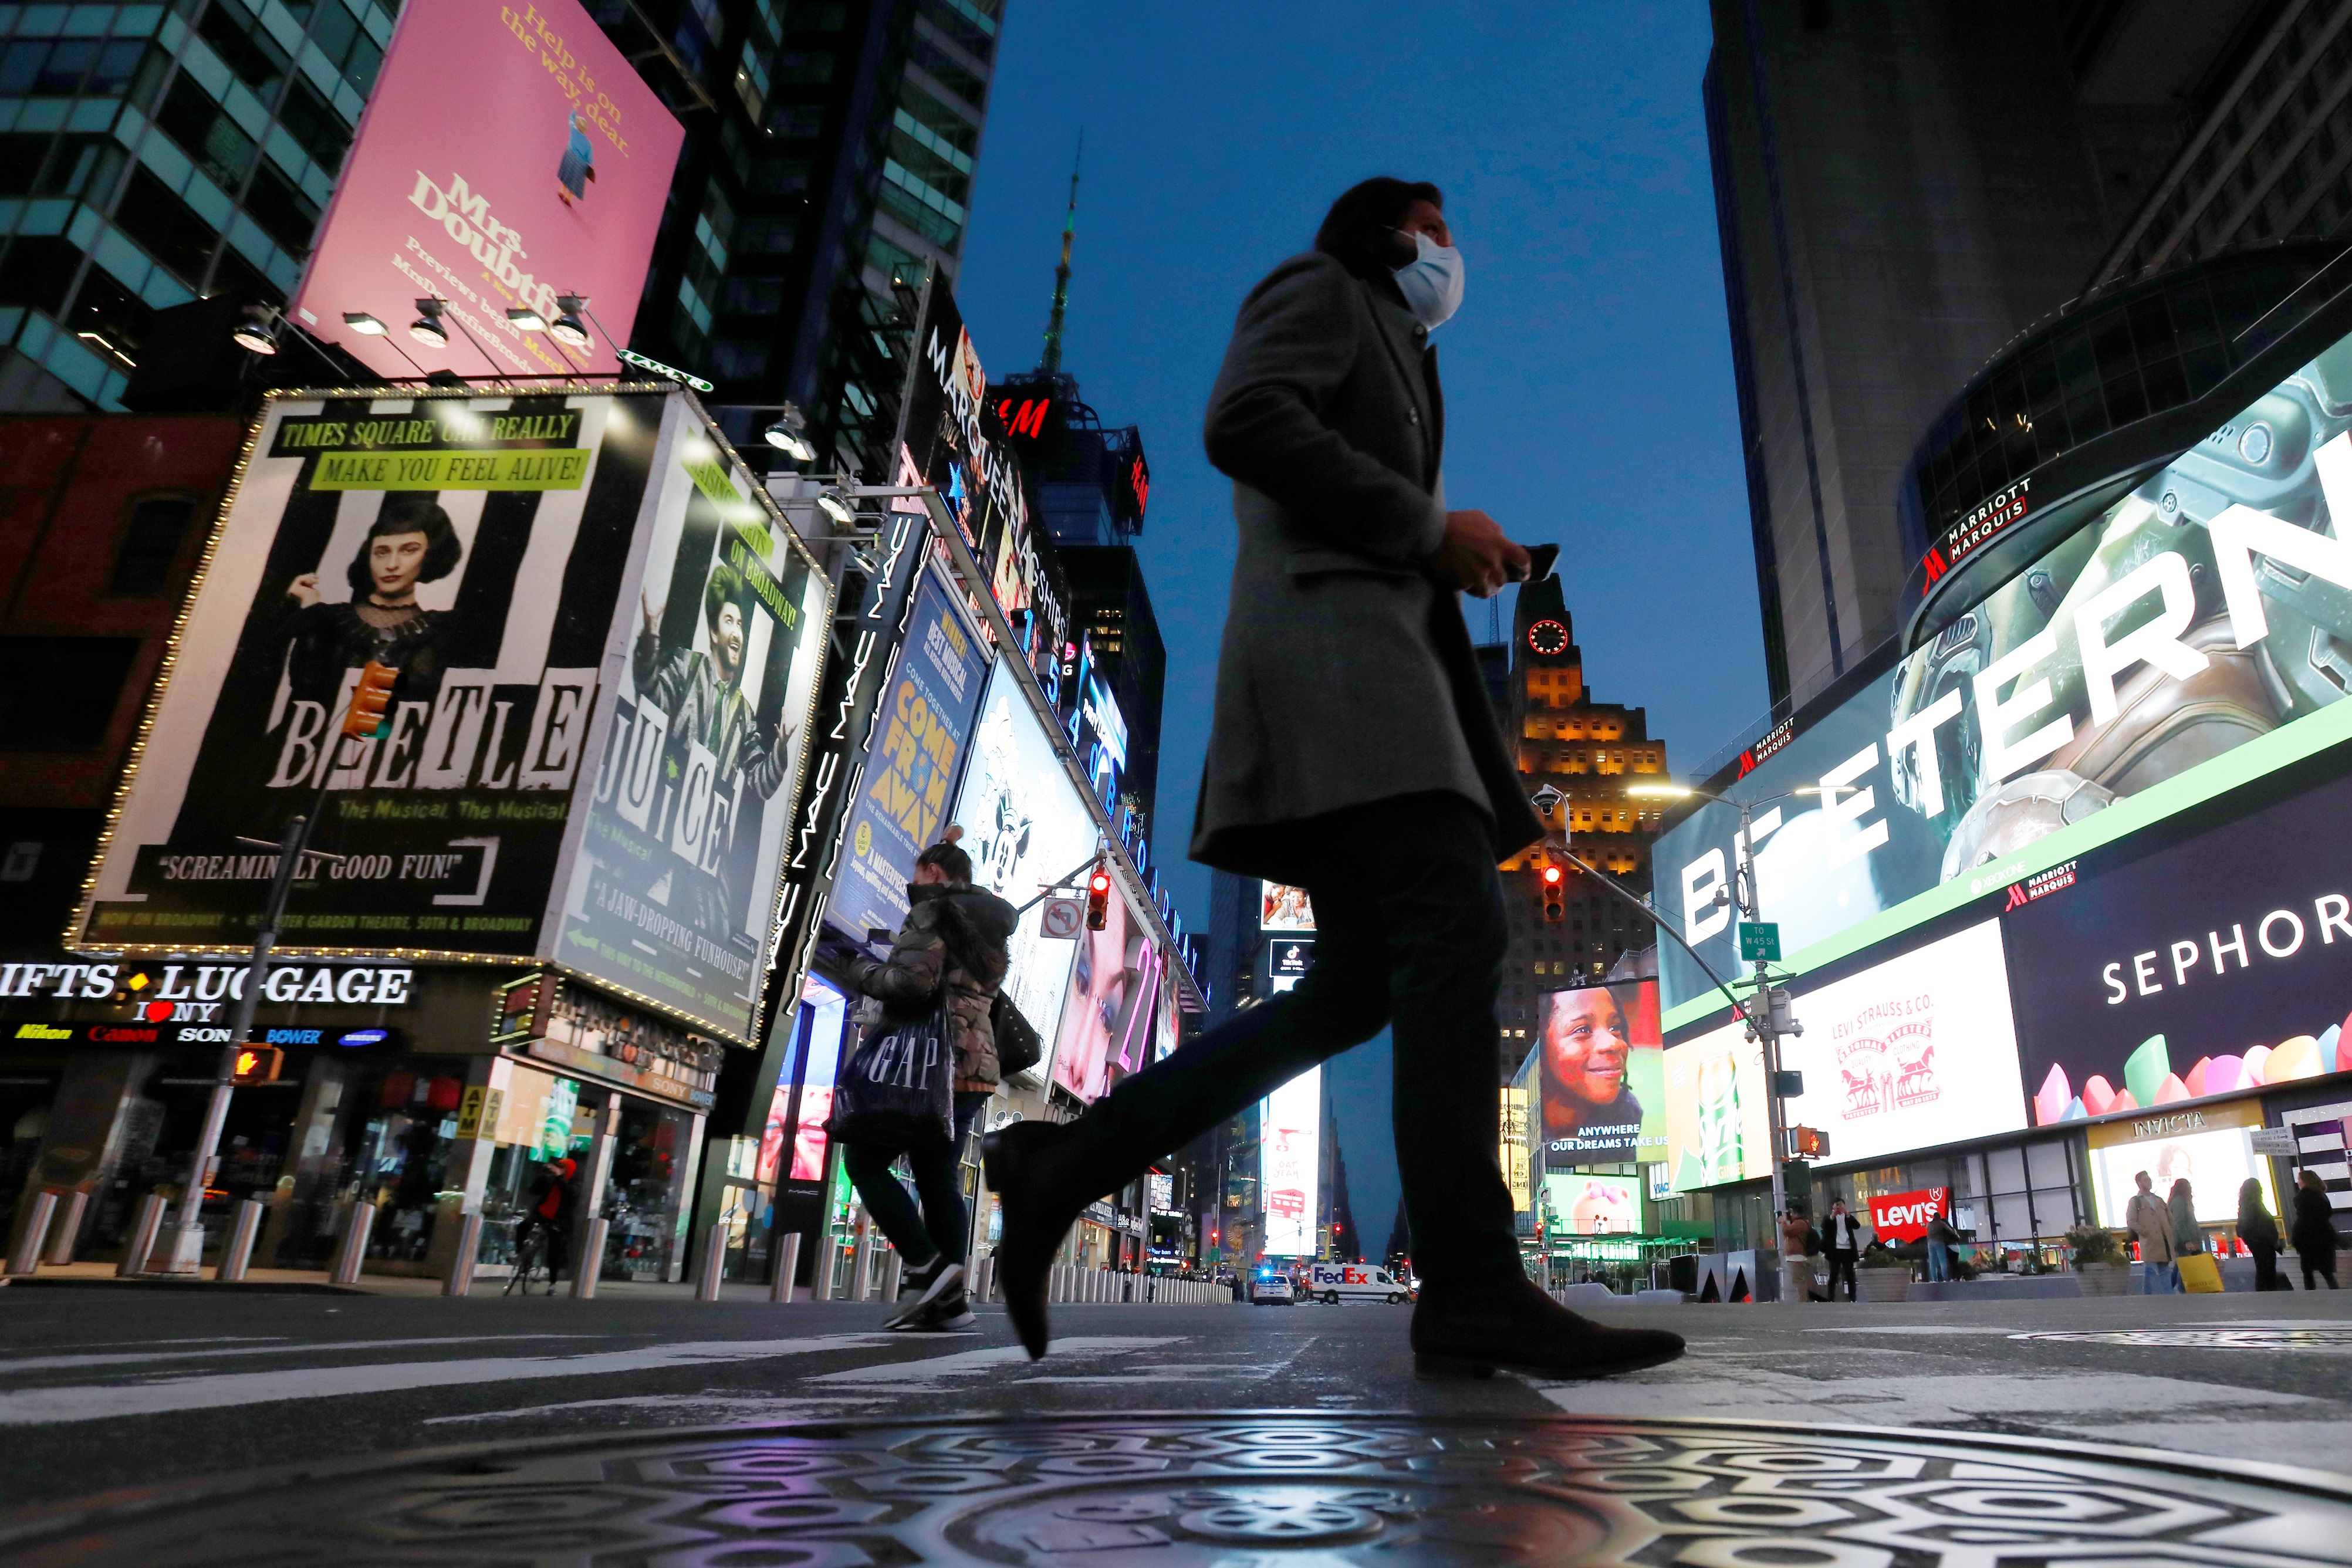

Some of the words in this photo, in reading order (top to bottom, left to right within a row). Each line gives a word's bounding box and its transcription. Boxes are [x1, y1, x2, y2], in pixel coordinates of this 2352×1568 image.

[524, 3, 575, 69] Help
[577, 65, 595, 92] is
[598, 92, 621, 124] on
[501, 6, 537, 53] the
[542, 50, 582, 110] way,
[586, 103, 629, 158] dear.
[444, 171, 528, 259] Mrs.
[405, 235, 478, 303] Previews
[481, 297, 520, 340] begin
[624, 352, 705, 389] LAMAR
[282, 423, 346, 447] TIMES
[350, 419, 435, 449] SQUARE
[492, 414, 575, 440] REALLY
[927, 324, 1006, 520] MARQUEE
[322, 459, 389, 482] MAKE
[397, 458, 441, 481] YOU
[445, 458, 498, 481] FEEL
[507, 456, 581, 481] ALIVE!
[1948, 478, 2031, 543] MARRIOTT
[1951, 502, 2023, 560] MARQUIS
[731, 539, 746, 570] ON
[745, 555, 797, 631] BROADWAY!
[1009, 506, 1066, 648] FLAGSHIPS
[941, 608, 968, 661] WINNER!
[927, 619, 945, 655] BEST
[941, 641, 967, 692] MUSICAL
[906, 662, 924, 692] COME
[925, 686, 953, 734] TOGETHER
[952, 727, 961, 742] AT
[897, 680, 957, 779] COME
[1756, 717, 1795, 751] MARRIOTT
[1757, 731, 1792, 763] MARQUIS
[883, 714, 948, 818] FROM
[339, 799, 370, 817] The
[458, 799, 492, 819] The
[588, 810, 610, 838] The
[869, 764, 938, 851] AWAY
[866, 799, 875, 815] THE
[874, 809, 903, 843] REMARKABLE
[903, 837, 914, 854] TRUE
[158, 855, 321, 880] "SCREAMINLY
[330, 854, 393, 880] GOOD
[1983, 869, 2007, 888] XBOX
[2006, 860, 2026, 878] ONE
[2028, 860, 2078, 888] MARRIOTT
[880, 884, 890, 897] and
[2030, 873, 2073, 899] MARQUIS
[462, 917, 533, 931] BROADWAY
[608, 888, 693, 952] JAW-DROPPING
[15, 1024, 72, 1040] Nikon
[88, 1026, 160, 1043] Canon
[177, 1028, 252, 1043] SON
[265, 1029, 322, 1045] BOWER
[1832, 1020, 1854, 1040] LEVI
[1857, 1001, 1902, 1030] STRAUSS
[1906, 1000, 1913, 1015] &
[1915, 994, 1934, 1012] CO.
[1839, 1039, 1883, 1062] ORIGINAL
[1884, 1024, 1930, 1048] RIVETED
[1851, 1055, 1871, 1069] QUALITY
[1893, 1040, 1921, 1056] CLOTHING
[869, 1035, 938, 1090] GAP
[653, 1077, 687, 1097] SONY
[461, 1089, 481, 1131] ATM
[481, 1091, 499, 1133] ATM
[1845, 1107, 1877, 1120] PATENTED
[1901, 1099, 1914, 1107] MAY
[2132, 1111, 2207, 1138] INVICTA
[1550, 1140, 1575, 1152] OUR
[1577, 1138, 1622, 1151] DREAMS
[1624, 1137, 1653, 1148] TAKE
[1655, 1135, 1668, 1145] US
[1577, 1123, 1640, 1137] ANYWHERE
[1273, 1168, 1300, 1180] YEAH
[1279, 1160, 1298, 1169] OAT
[1654, 1181, 1670, 1194] VIAC
[1314, 1266, 1368, 1285] FedEx
